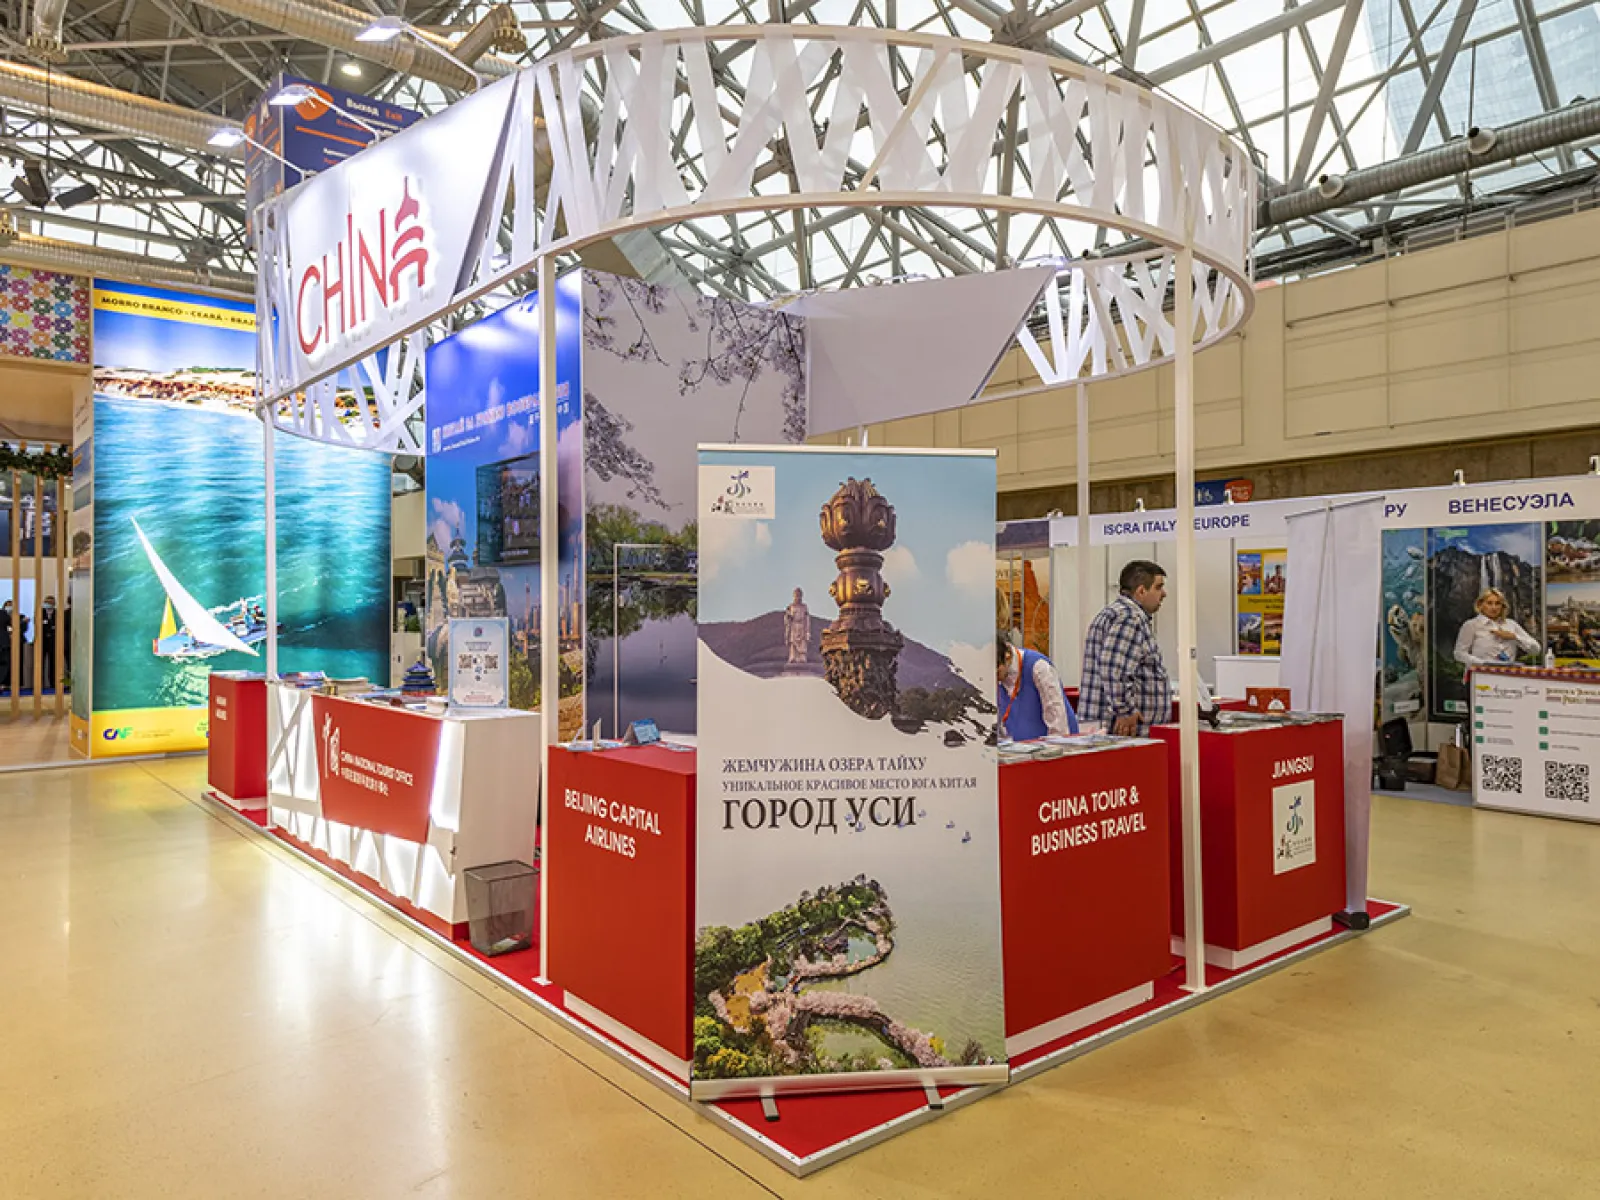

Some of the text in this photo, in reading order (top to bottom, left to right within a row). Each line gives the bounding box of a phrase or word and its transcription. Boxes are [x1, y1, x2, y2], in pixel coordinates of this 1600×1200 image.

[297, 176, 428, 355] CHINA
[101, 296, 140, 309] MORRO
[142, 302, 183, 316] BRANCO
[230, 316, 257, 327] BRAZ
[1384, 503, 1407, 518] РУ
[1448, 492, 1575, 514] ВЕНЕСУЭЛА
[1103, 514, 1250, 536] ISCRA ITALY EUROPE
[722, 754, 927, 773] ЖЕМЧУЖИНА ОЗЕРА ТАЙХУ
[1272, 755, 1314, 779] JIANGSU
[721, 777, 977, 792] УНИКАЛЬНОЕ КРАСИВОЕ МЕСТО ЮГА КИТАЯ
[564, 788, 662, 836] BEIJING CAPITAL
[722, 796, 917, 834] ГОРОД УСИ
[1038, 785, 1140, 823] CHINA TOUR &
[584, 824, 636, 859] AIRLINES
[1031, 812, 1147, 856] BUSINESS TRAVEL
